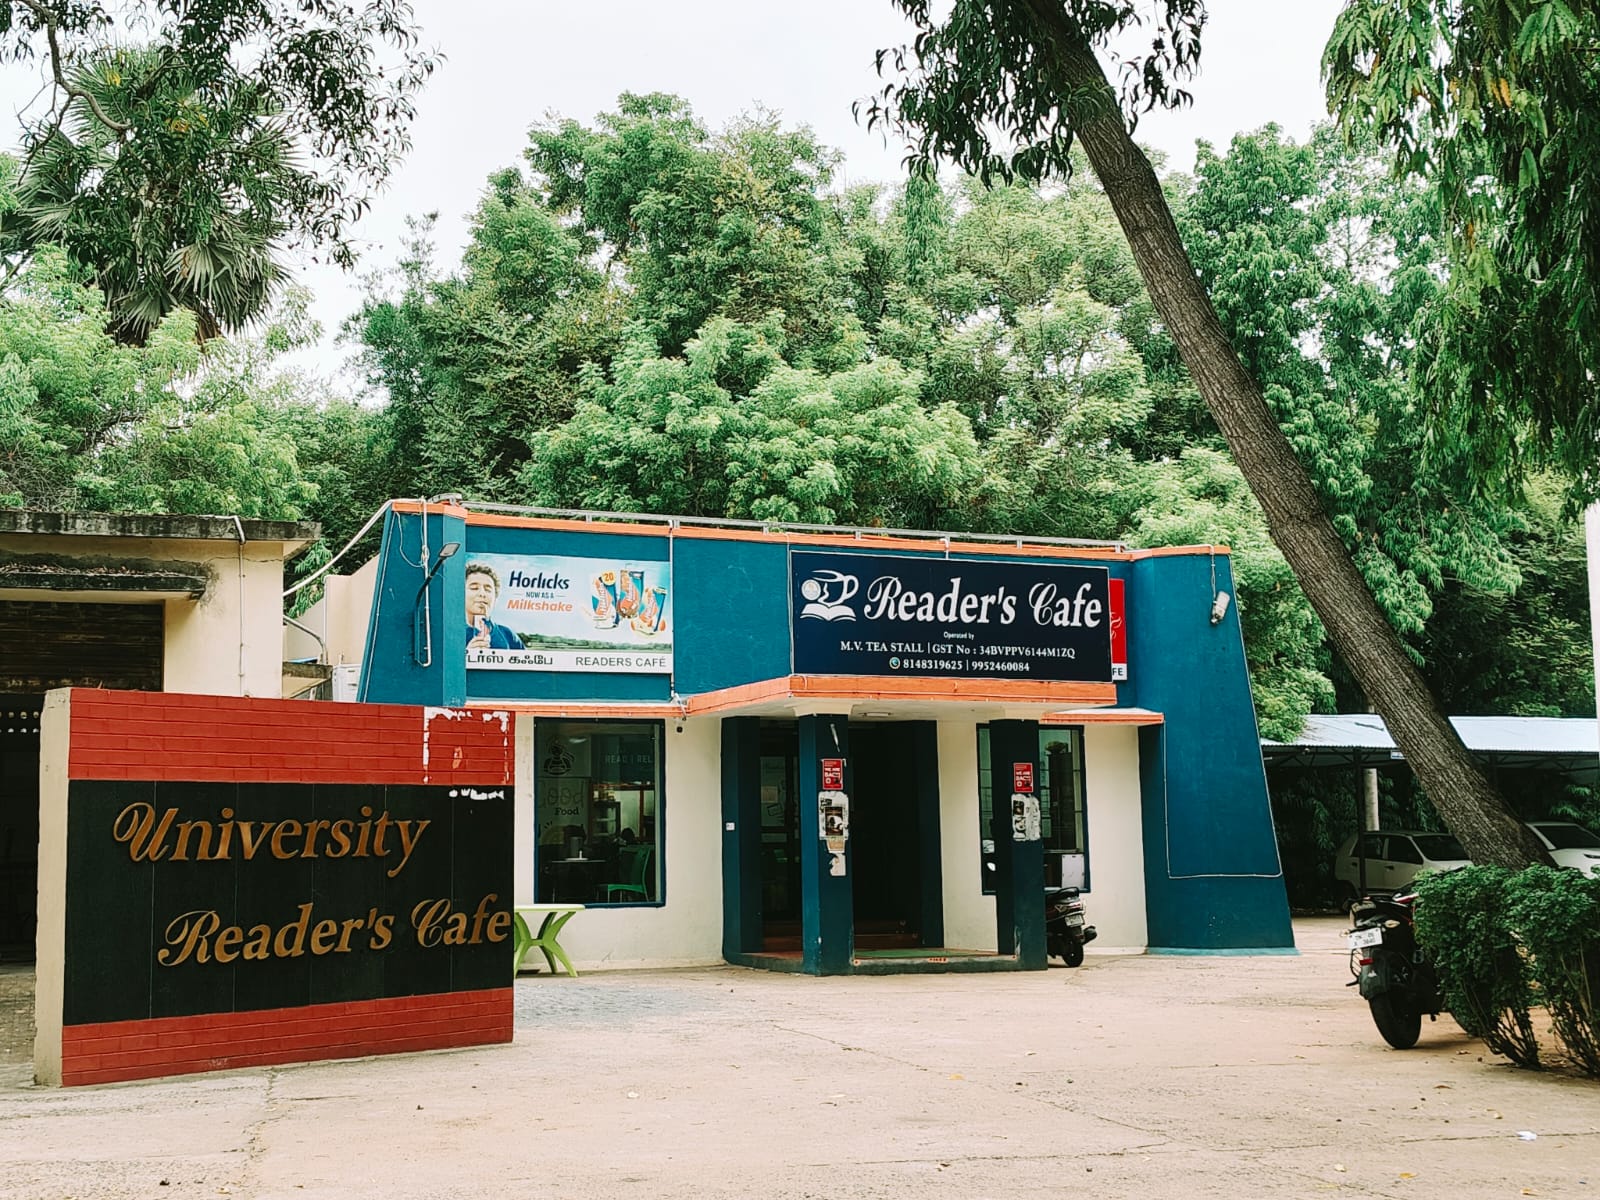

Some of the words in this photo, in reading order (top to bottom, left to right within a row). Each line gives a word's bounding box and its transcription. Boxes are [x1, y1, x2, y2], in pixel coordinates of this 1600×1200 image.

[508, 570, 570, 590] Horlicks
[507, 599, 573, 613] Milkshake
[863, 576, 1017, 625] Reader's
[1029, 582, 1102, 628] Cafe
[943, 631, 967, 639] Operated
[968, 632, 975, 641] by
[840, 640, 864, 651] M.V.
[865, 641, 888, 652] TEA
[890, 642, 925, 653] STALL
[932, 644, 954, 654] GST
[956, 645, 971, 655] No
[466, 650, 504, 664] டர்ஸ்
[575, 656, 632, 667] READERS
[903, 659, 963, 670] 8148319625
[971, 660, 1031, 672] 9952460084
[554, 807, 580, 816] Food
[112, 800, 432, 878] University
[157, 902, 396, 967] Reader's
[411, 892, 512, 949] Cafe
